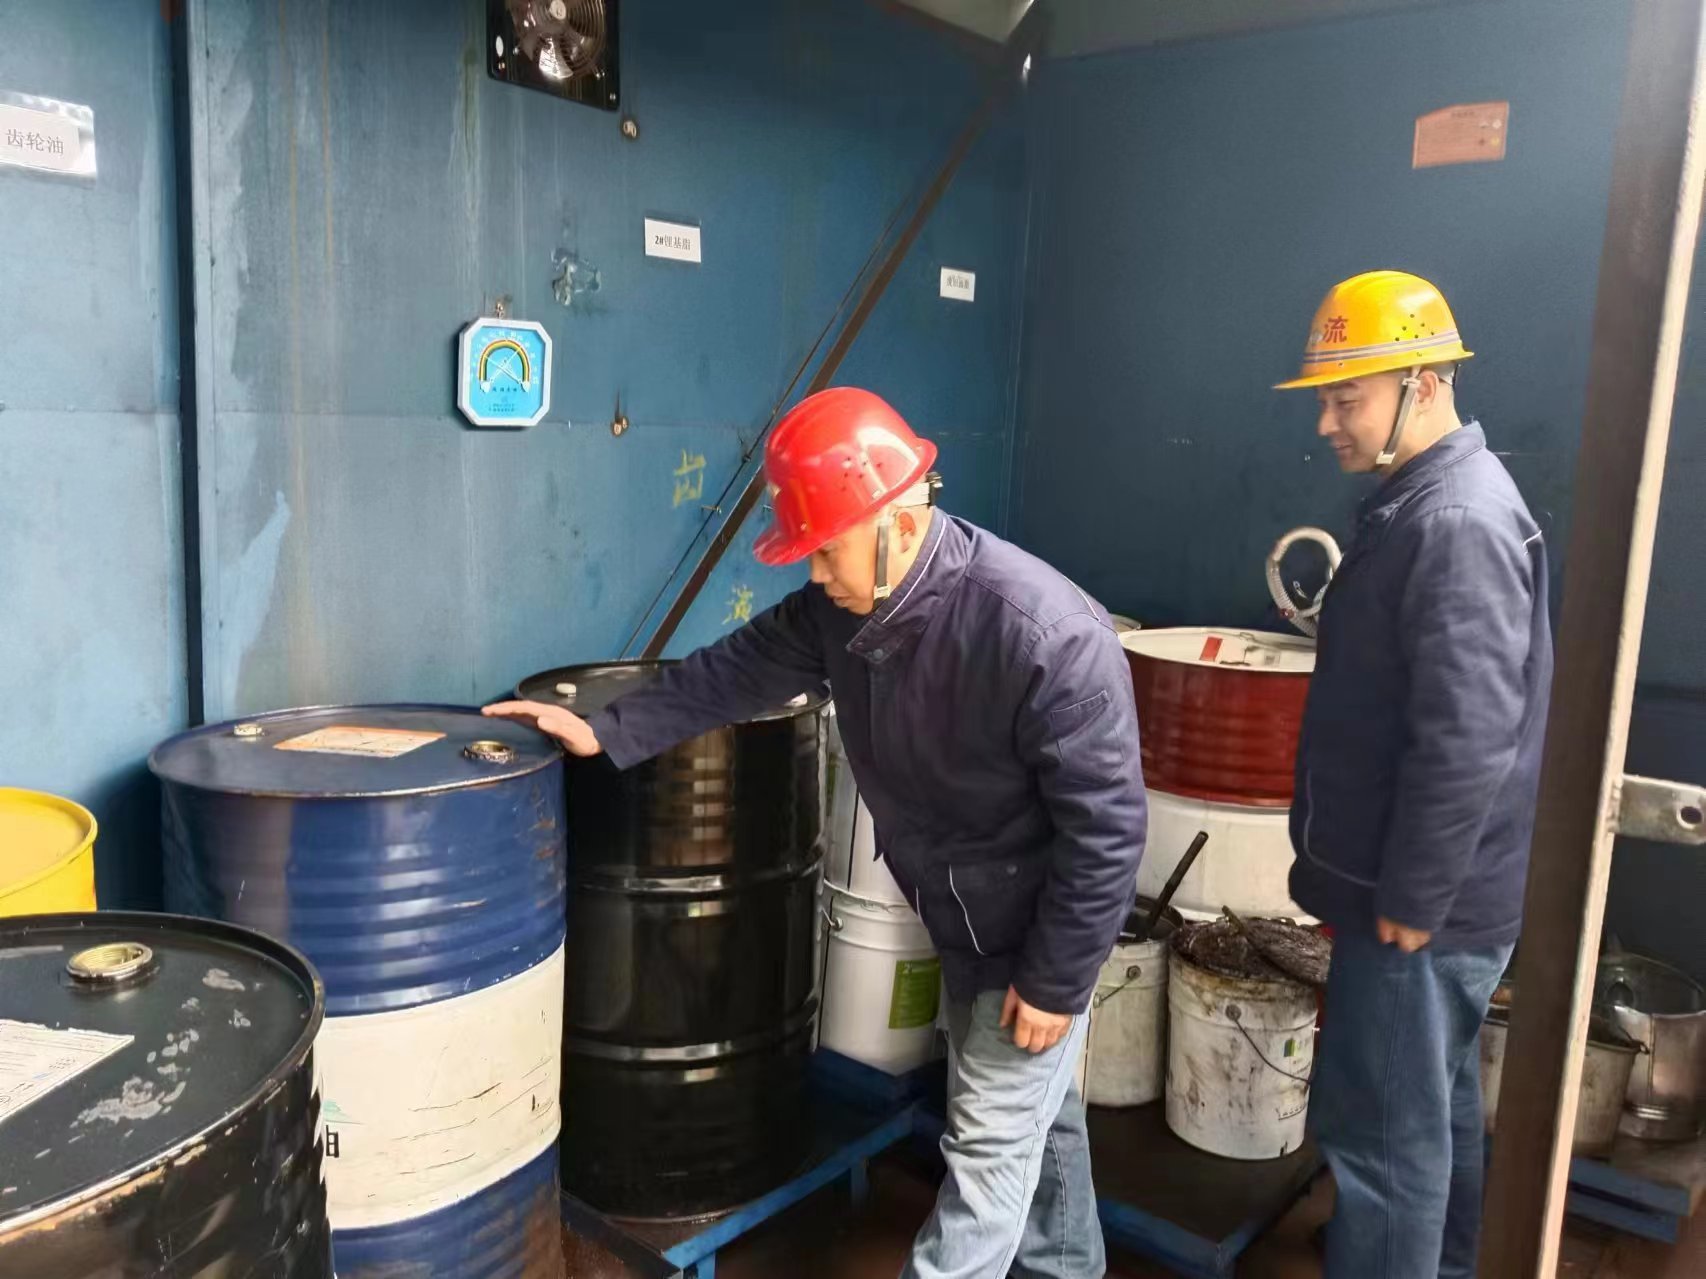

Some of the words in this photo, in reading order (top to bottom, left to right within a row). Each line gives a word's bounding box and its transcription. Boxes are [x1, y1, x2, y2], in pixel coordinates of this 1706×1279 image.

[6, 128, 64, 155] 齿轮油
[655, 234, 691, 251] 2#锂基脂
[1323, 315, 1349, 344] 流
